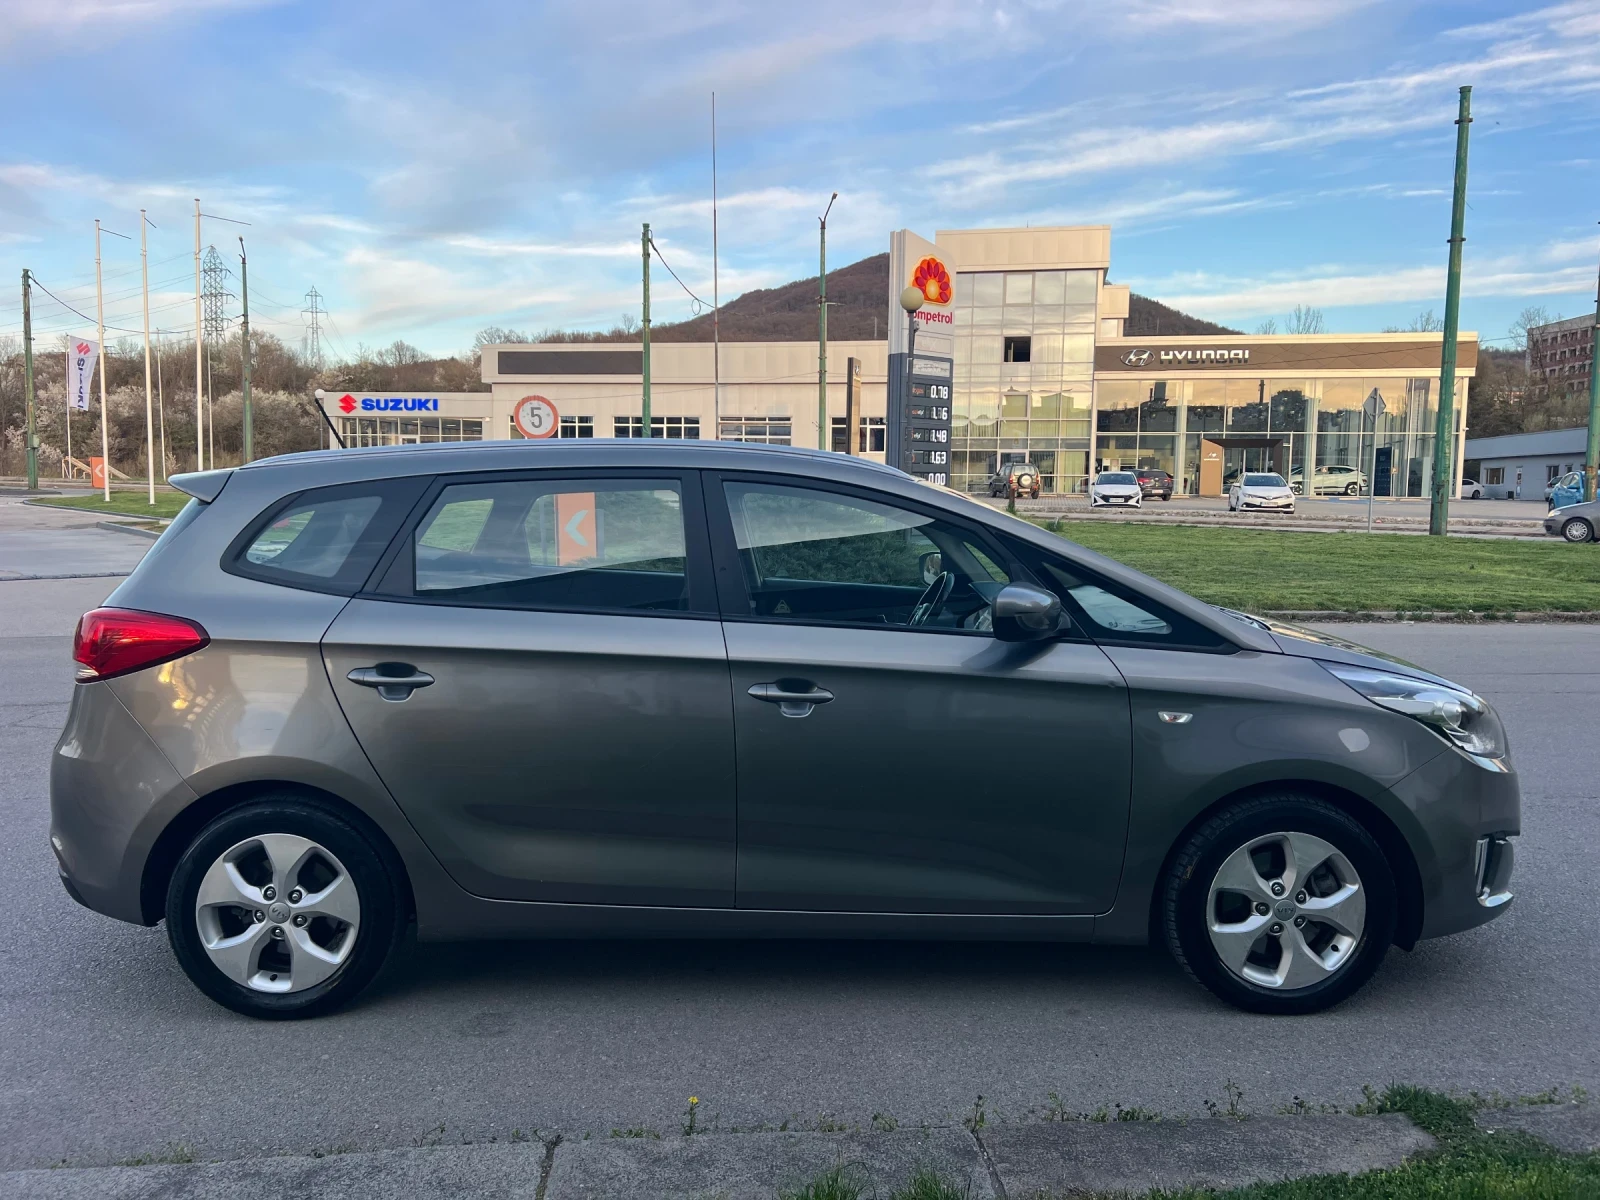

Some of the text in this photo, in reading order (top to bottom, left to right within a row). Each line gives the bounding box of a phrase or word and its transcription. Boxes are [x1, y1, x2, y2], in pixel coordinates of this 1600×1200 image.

[907, 310, 953, 325] ompetrol
[1160, 350, 1250, 364] HYUNDAI
[930, 385, 949, 399] 0.78
[361, 398, 439, 412] SUZUKI
[530, 406, 543, 429] 5
[931, 429, 948, 443] 1.48
[930, 451, 947, 464] 1.63
